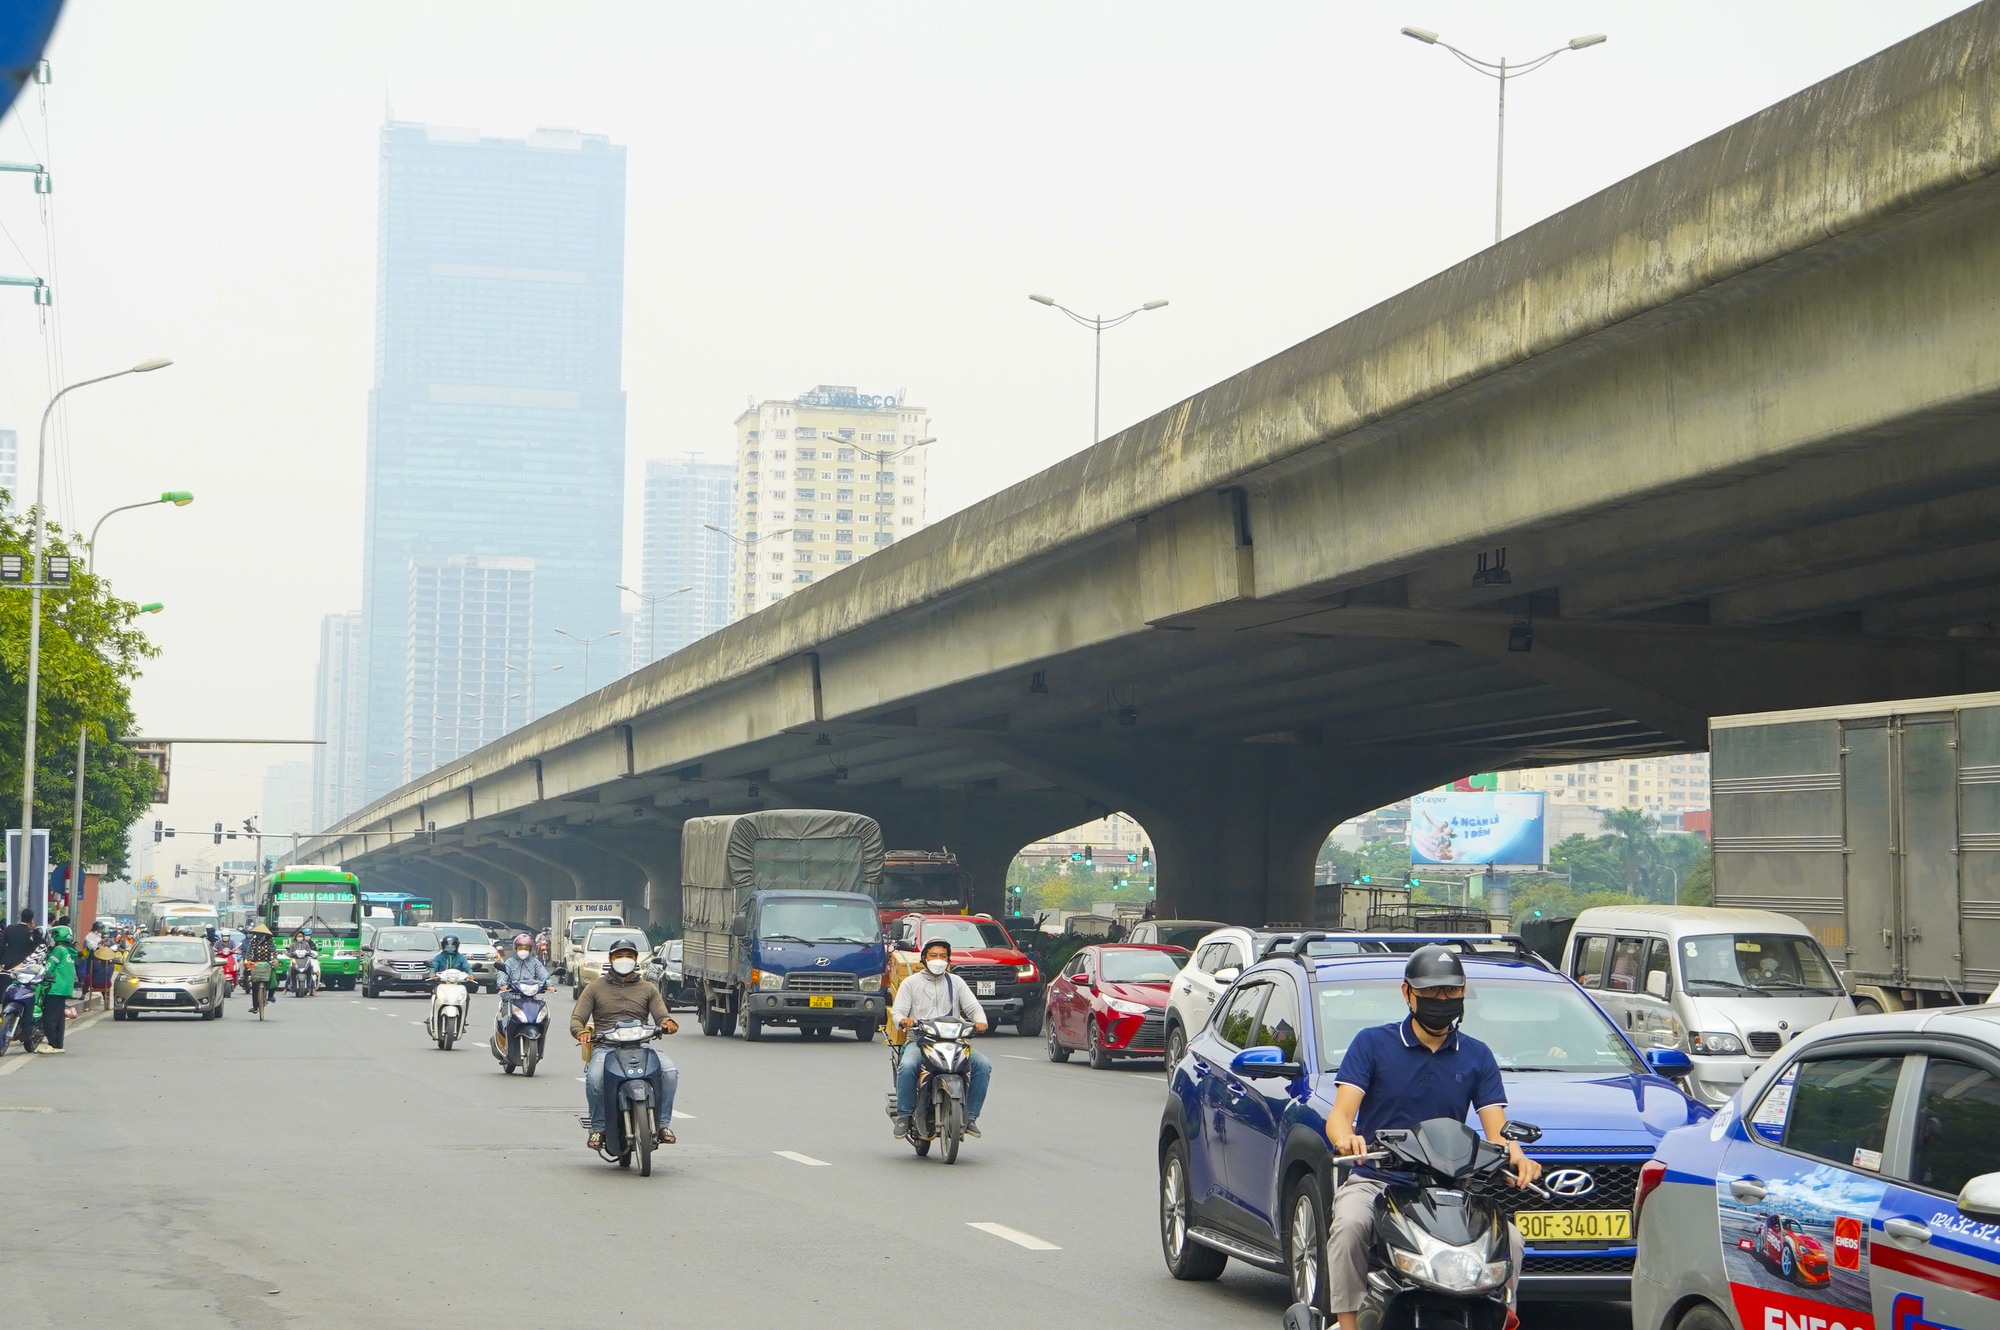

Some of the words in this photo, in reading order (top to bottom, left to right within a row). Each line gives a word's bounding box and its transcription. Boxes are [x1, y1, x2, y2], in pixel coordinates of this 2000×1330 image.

[1422, 796, 1447, 804] Casper
[1452, 817, 1459, 826] 4
[1464, 830, 1469, 839] 1
[316, 893, 334, 901] CAO
[1519, 1214, 1627, 1238] 30F-340.17
[1836, 1236, 1859, 1250] ENEOS
